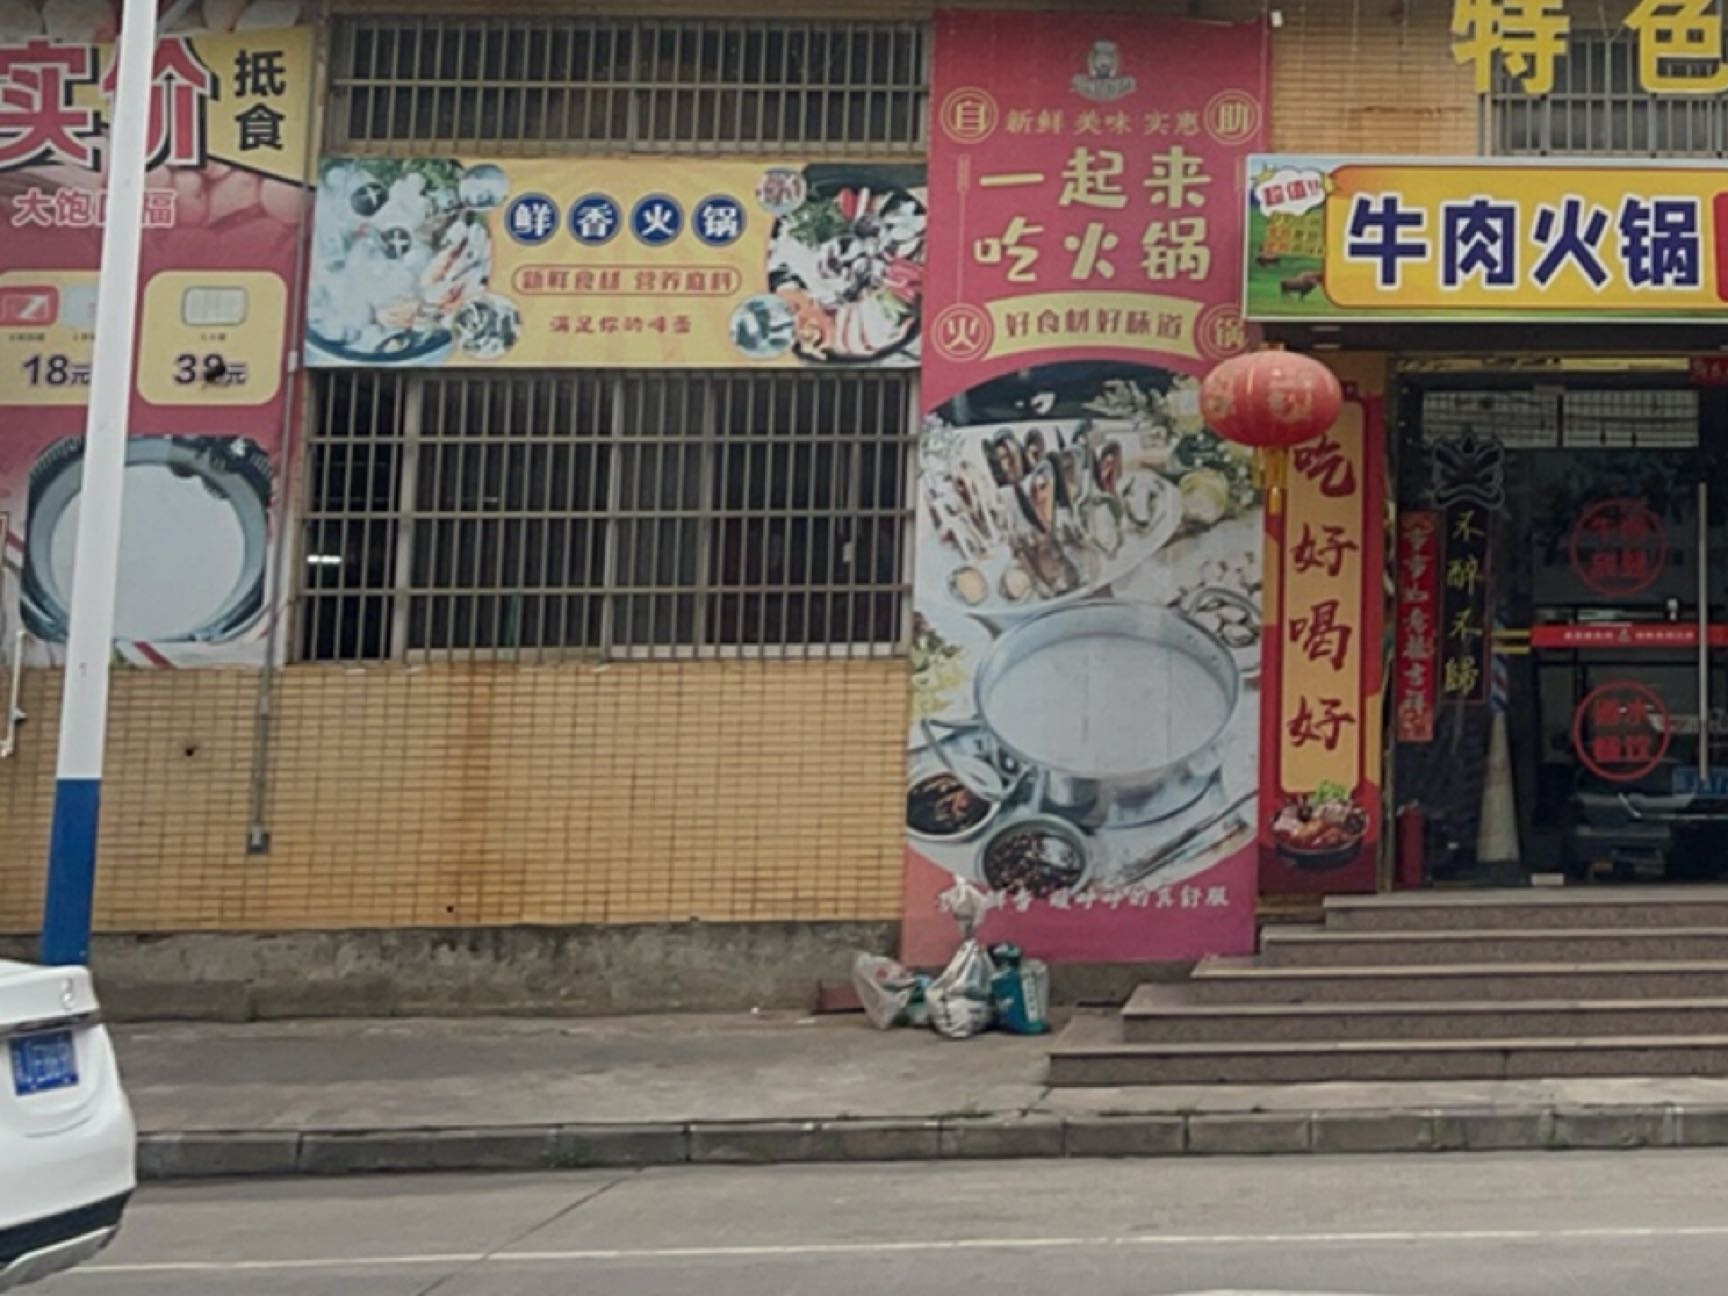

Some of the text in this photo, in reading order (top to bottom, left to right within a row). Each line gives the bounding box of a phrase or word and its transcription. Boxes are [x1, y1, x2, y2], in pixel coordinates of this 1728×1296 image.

[234, 49, 288, 151] 抵食
[11, 186, 178, 228] 大饱福
[978, 145, 1211, 209] 一起来
[507, 199, 744, 241] 鲜香火锅
[973, 216, 1211, 282] 吃火锅
[1346, 191, 1706, 292] 牛肉火锅
[1287, 431, 1358, 752] 吃好喝好
